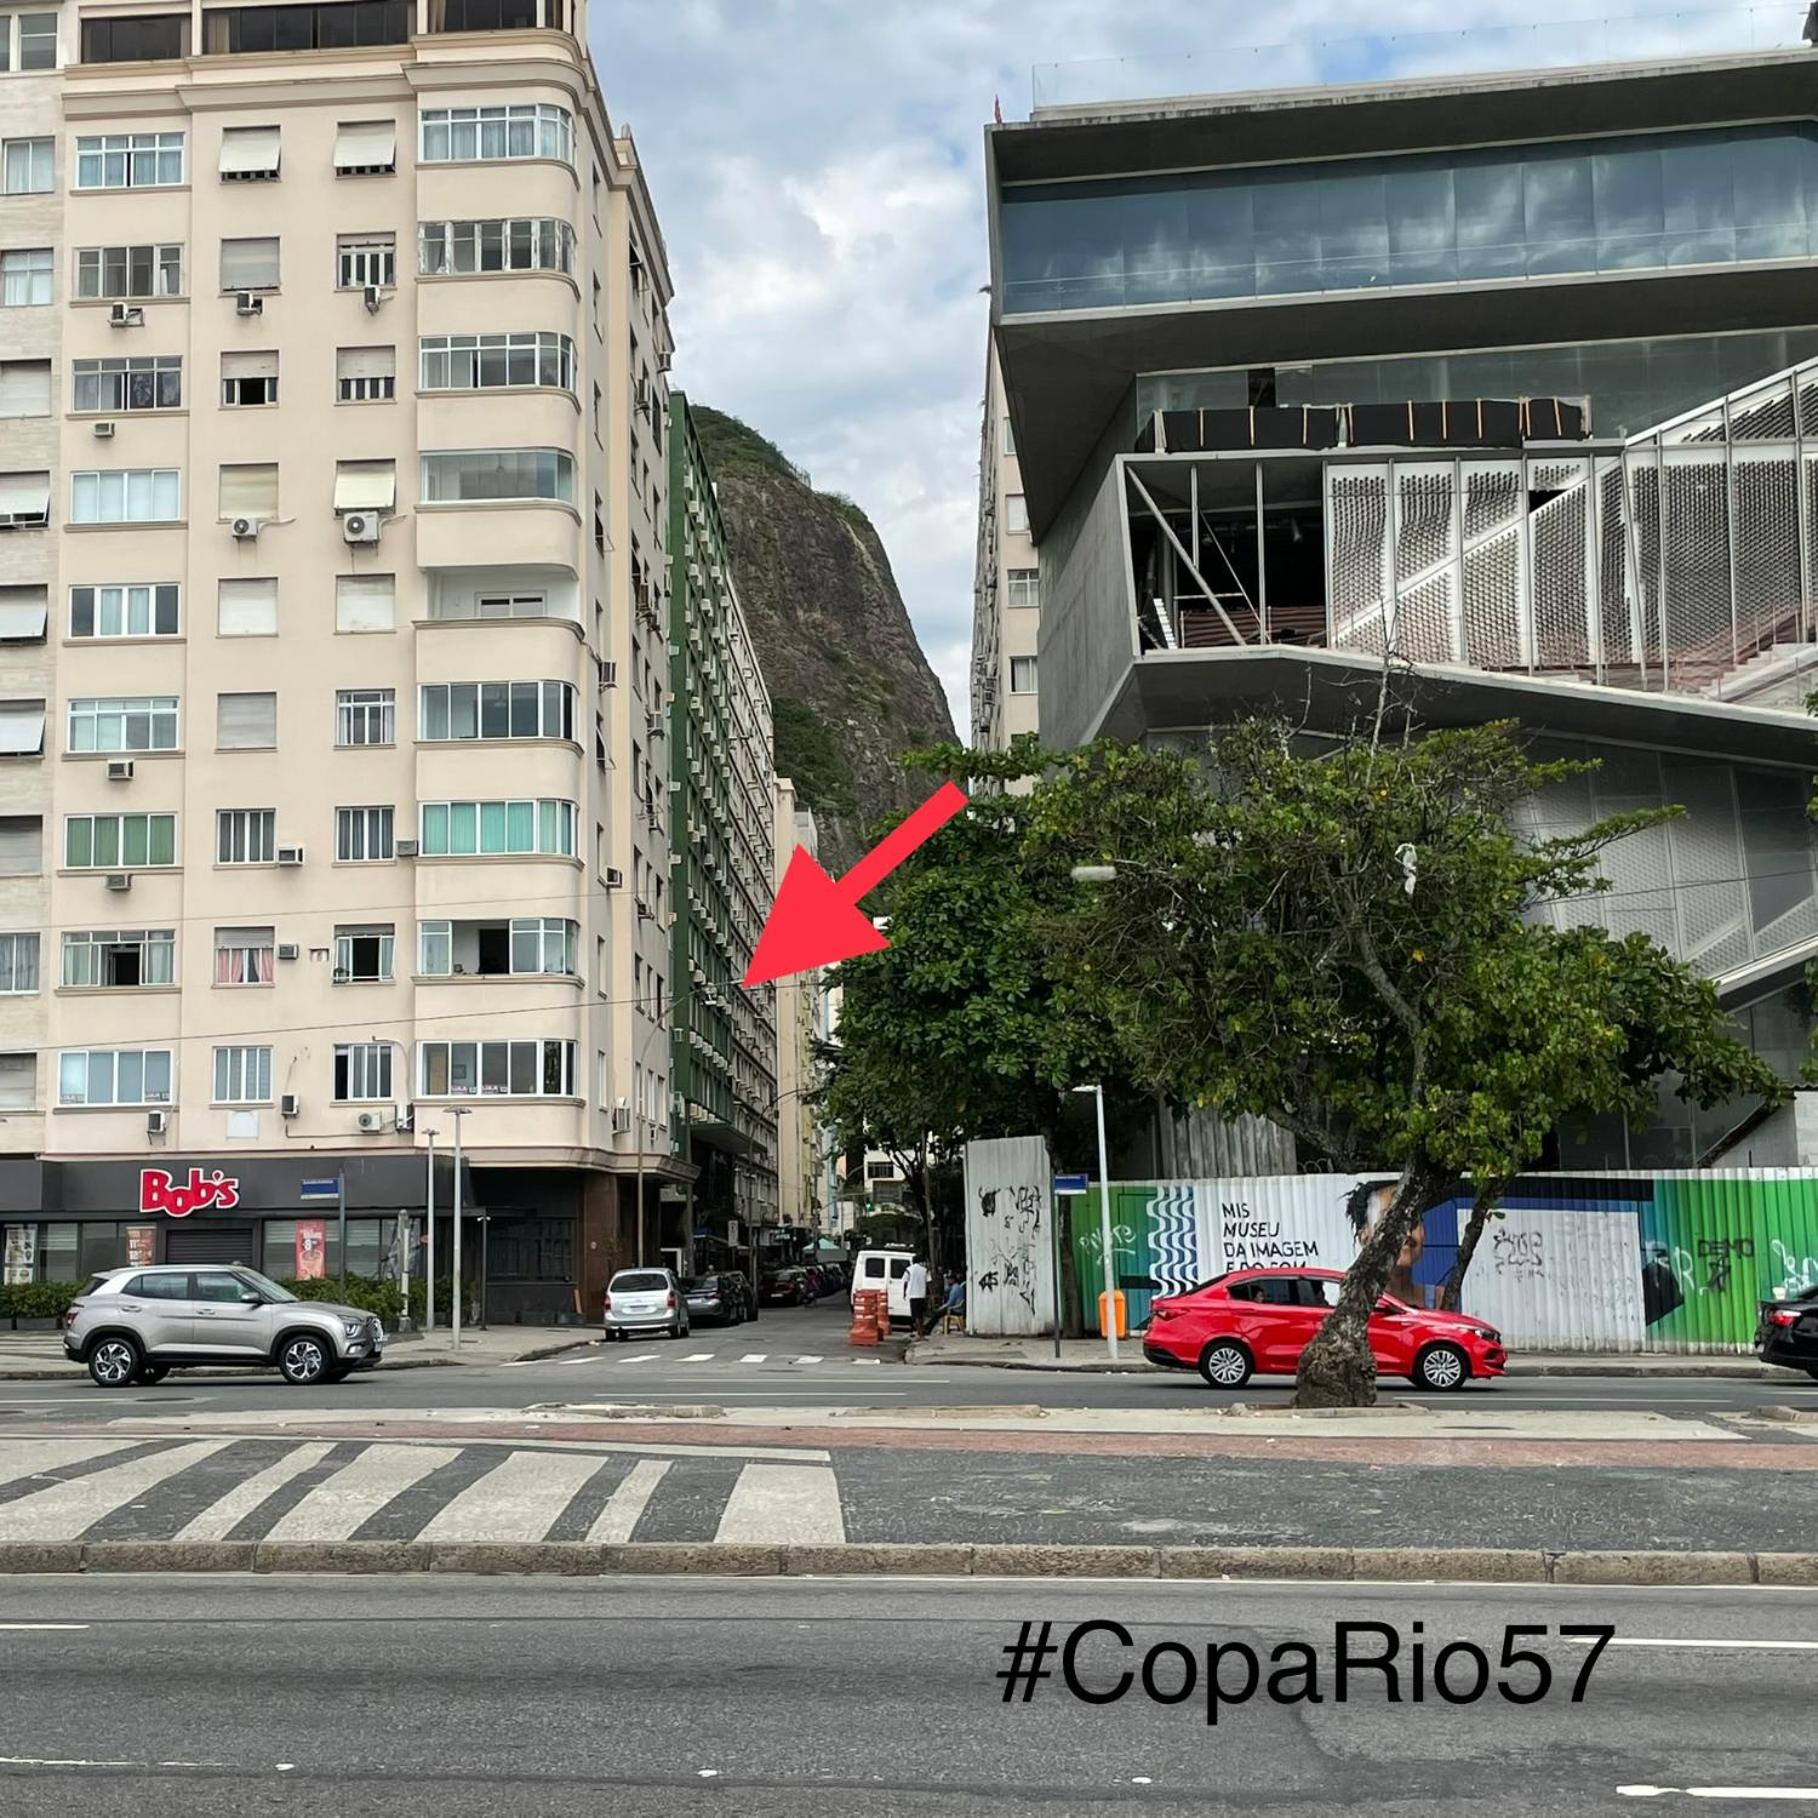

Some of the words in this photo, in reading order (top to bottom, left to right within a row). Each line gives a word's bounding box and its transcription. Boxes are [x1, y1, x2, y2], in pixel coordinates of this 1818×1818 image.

[140, 1168, 239, 1217] Bob's
[1222, 1203, 1250, 1218] MIS
[1223, 1222, 1280, 1238] MUSEU
[1223, 1242, 1247, 1258] DA
[1250, 1241, 1319, 1258] IMAGEM
